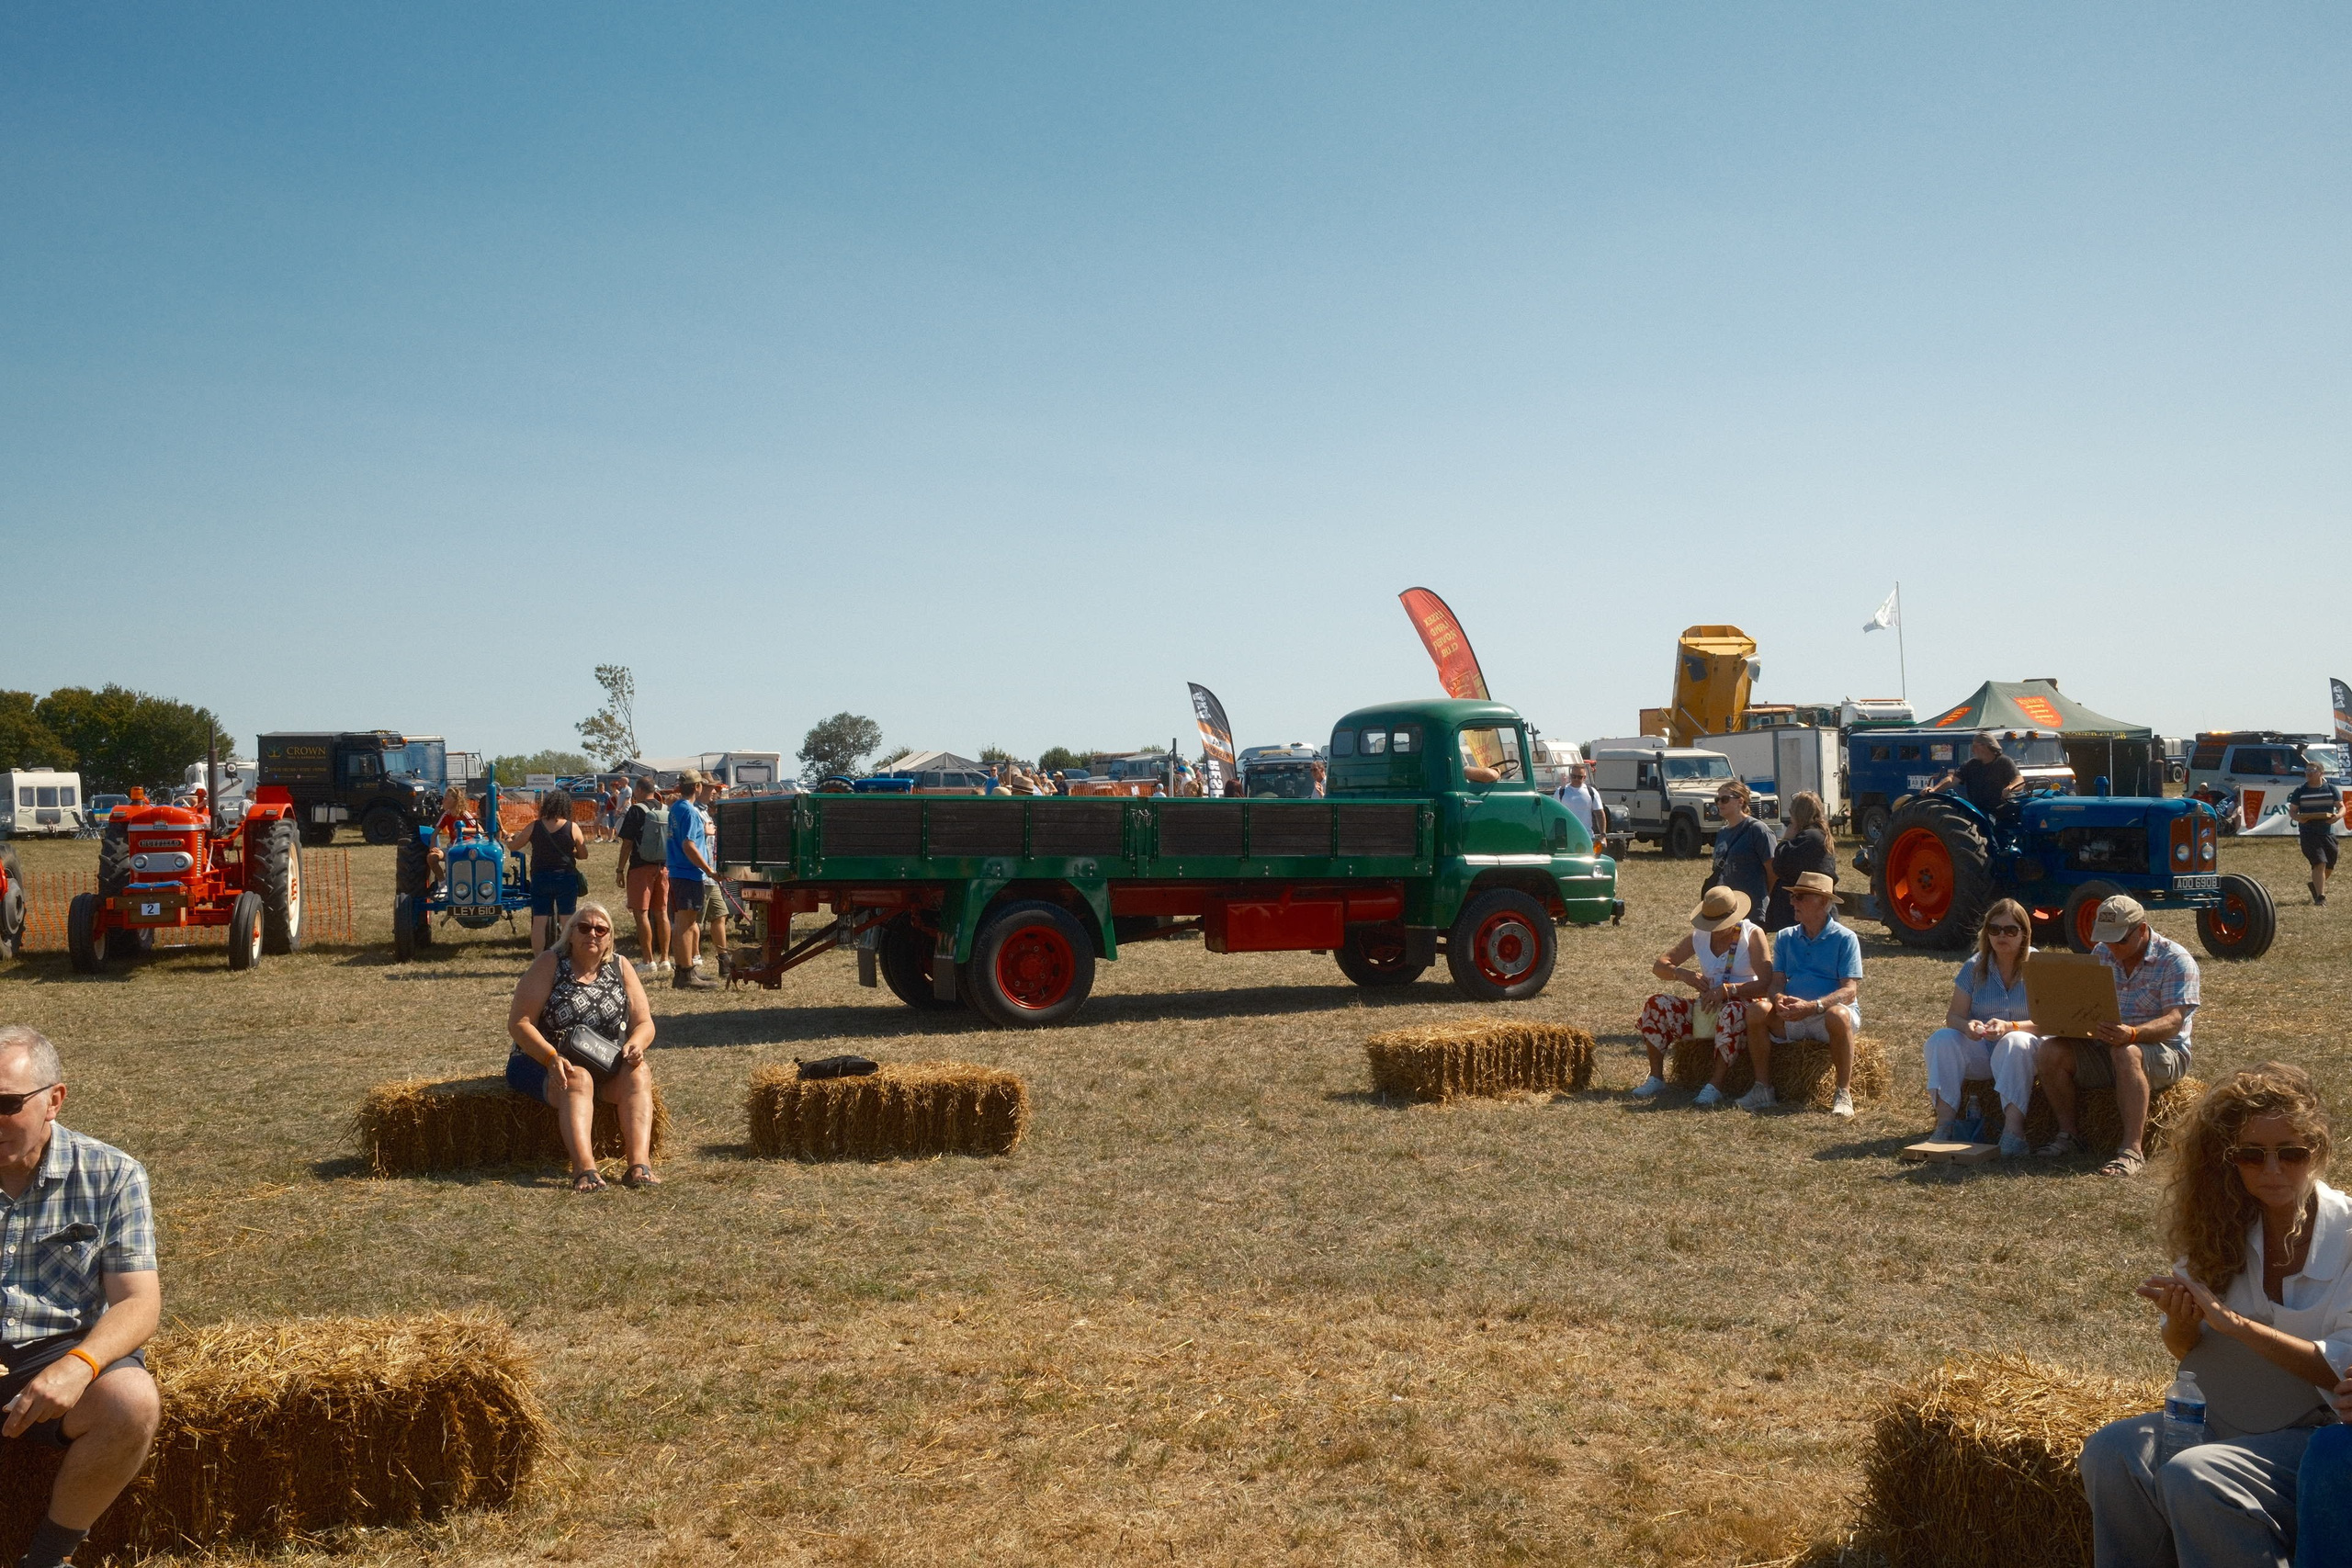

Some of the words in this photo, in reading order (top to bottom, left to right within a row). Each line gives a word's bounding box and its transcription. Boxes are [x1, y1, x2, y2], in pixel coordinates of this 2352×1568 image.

[286, 746, 326, 756] CROWN
[2195, 876, 2218, 888] 690B
[147, 904, 154, 915] 2
[453, 907, 475, 916] LEY
[478, 906, 496, 915] 610
[594, 1041, 607, 1054] THE
